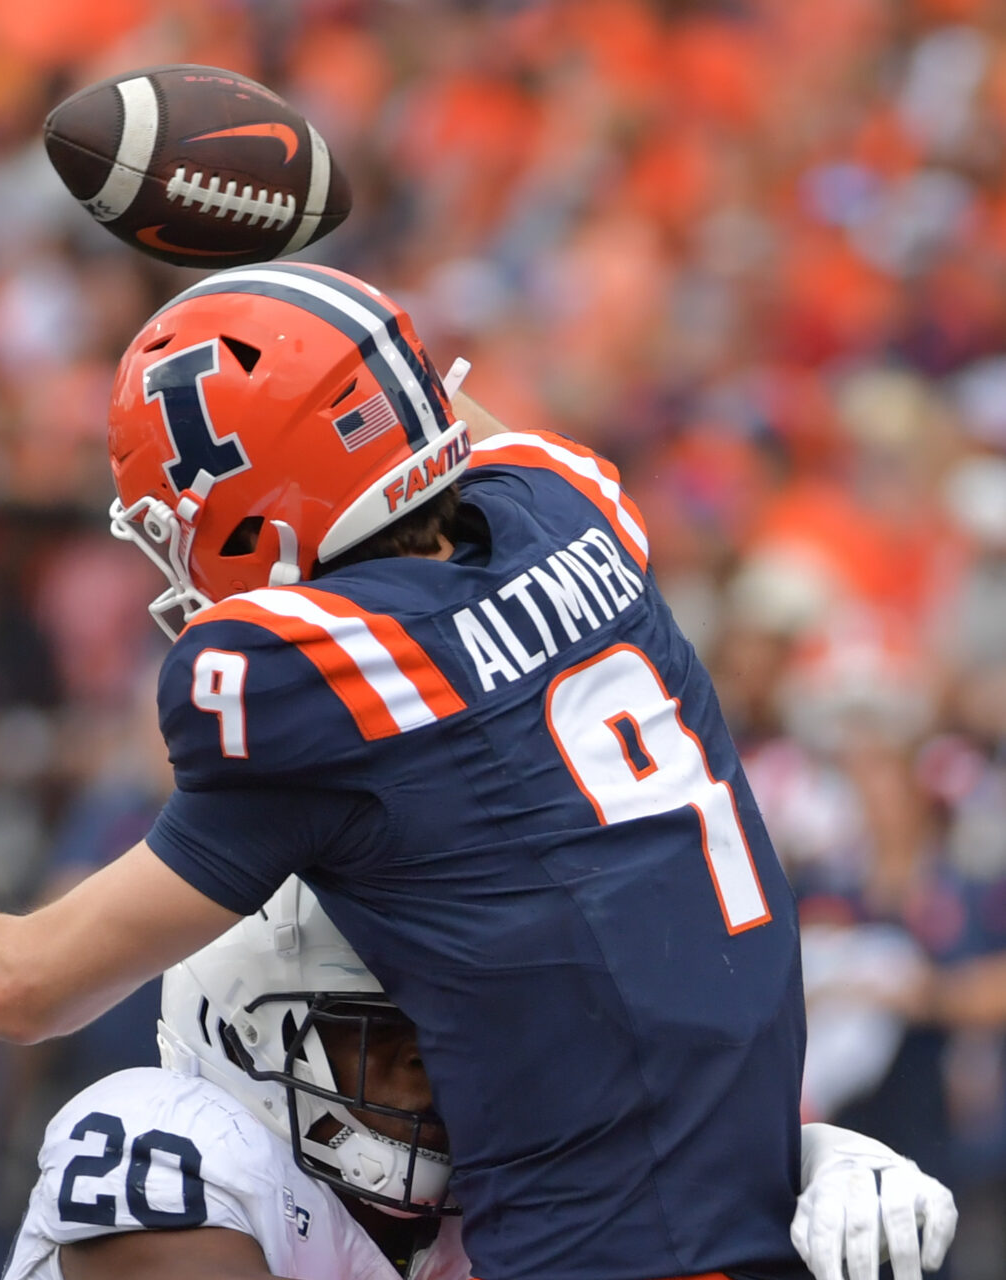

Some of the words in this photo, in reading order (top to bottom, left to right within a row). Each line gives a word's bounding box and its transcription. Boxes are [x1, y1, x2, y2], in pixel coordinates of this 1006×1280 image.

[452, 527, 645, 693] ALTMYER
[190, 647, 250, 760] 9
[545, 643, 773, 937] 9
[57, 1111, 208, 1229] 20
